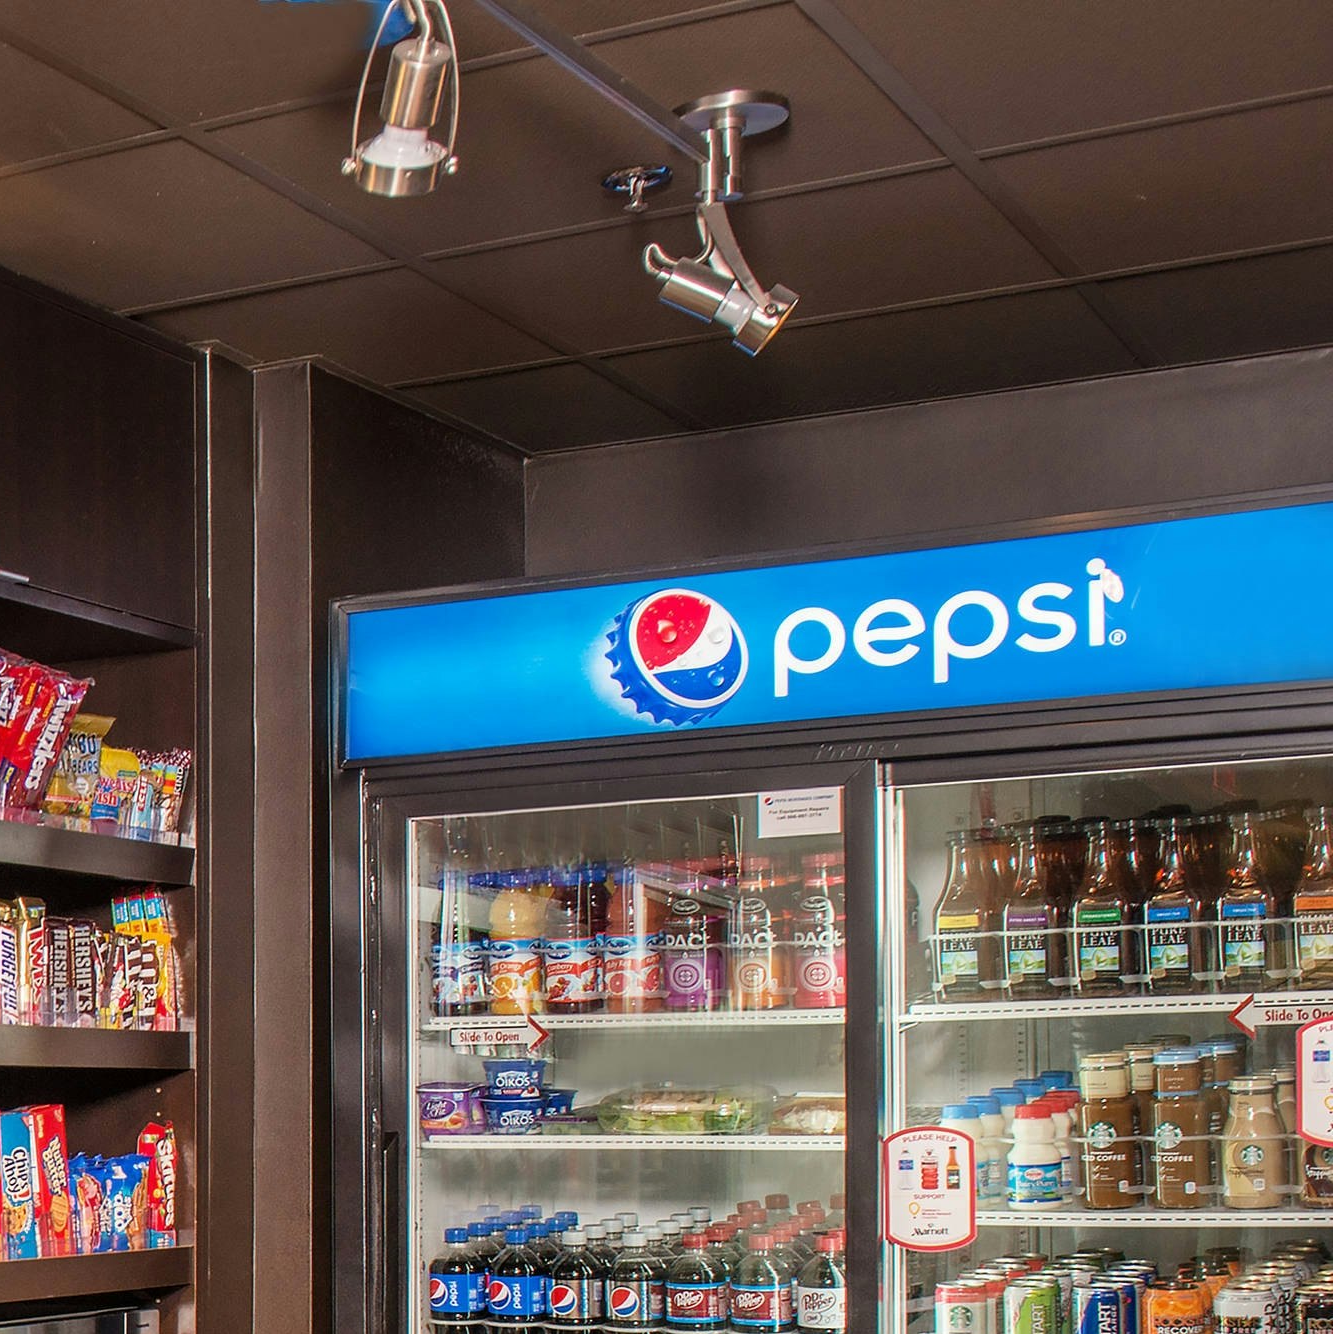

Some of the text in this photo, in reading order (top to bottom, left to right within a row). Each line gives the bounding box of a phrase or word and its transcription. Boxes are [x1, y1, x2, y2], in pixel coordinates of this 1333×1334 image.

[773, 557, 1108, 697] pepsi
[175, 766, 185, 798] KIND
[1082, 935, 1116, 947] LEAF
[1152, 934, 1185, 945] LEAF
[1227, 930, 1262, 942] LEAF
[75, 926, 92, 1015] HERSHEY'S
[1264, 1008, 1309, 1022] Slide To
[483, 1031, 493, 1042] To
[495, 1030, 520, 1044] Open
[495, 1075, 531, 1087] OIKOS
[426, 1100, 447, 1112] Light
[500, 1113, 534, 1126] OIKOS
[902, 1133, 958, 1143] PLEASE HELP
[48, 1135, 67, 1188] Nutter
[1096, 1153, 1126, 1162] COFFEE
[1162, 1155, 1193, 1163] COFFEE
[42, 1147, 62, 1197] Butter
[156, 1139, 175, 1228] Skittles
[911, 1227, 949, 1237] Marriott
[448, 1280, 459, 1307] pepsi
[512, 1283, 523, 1309] pepsi
[811, 1292, 823, 1302] Dr
[802, 1294, 834, 1311] Pepper
